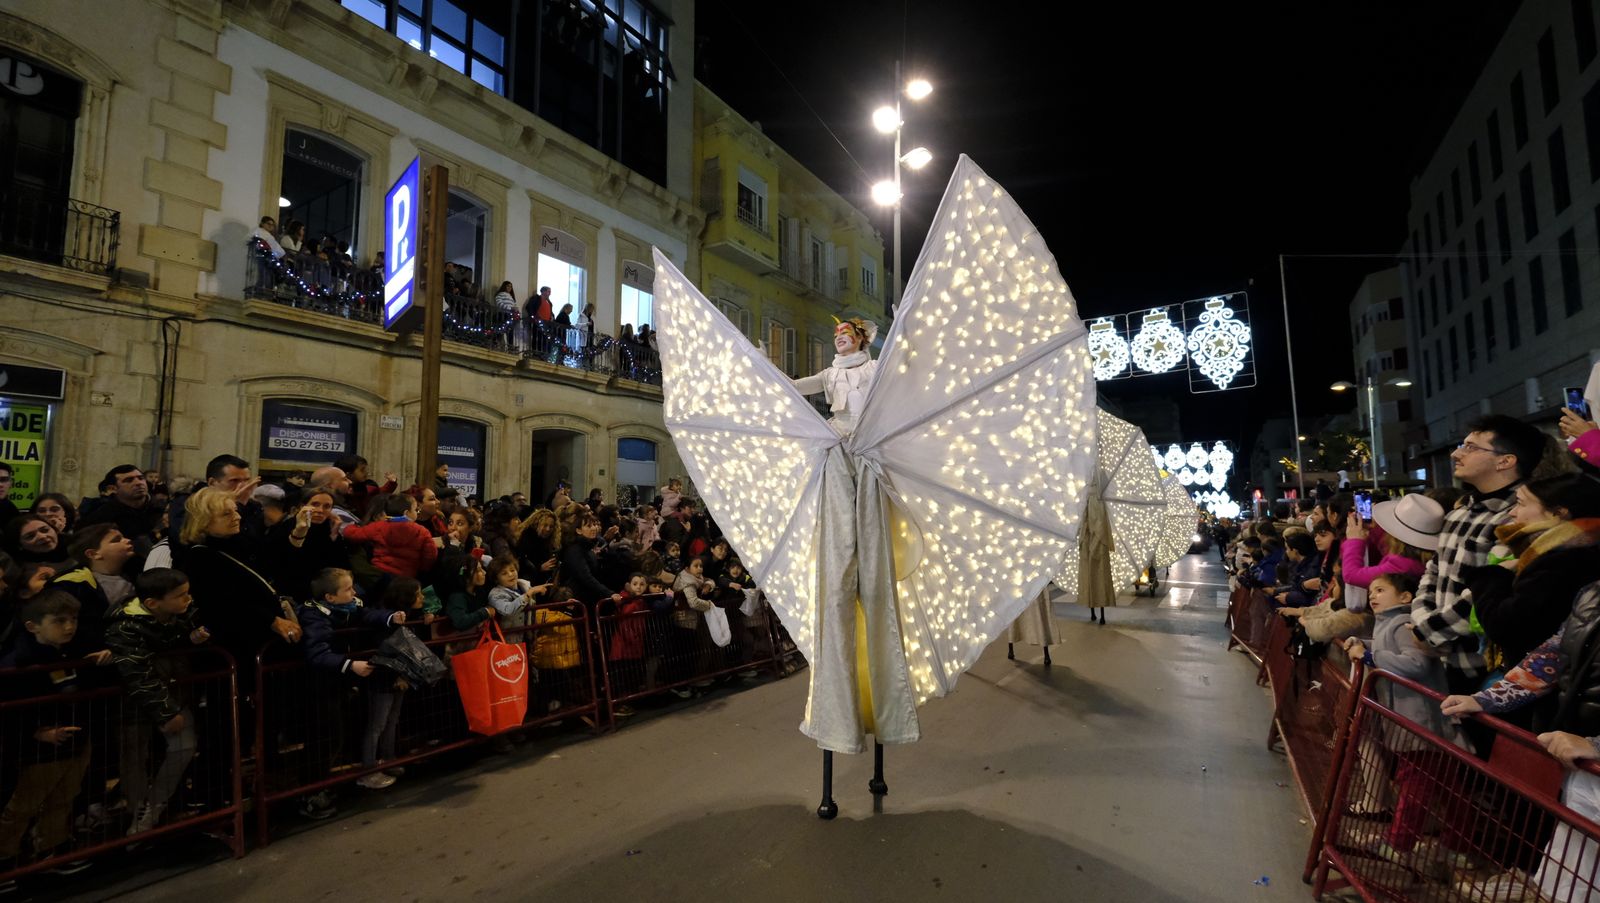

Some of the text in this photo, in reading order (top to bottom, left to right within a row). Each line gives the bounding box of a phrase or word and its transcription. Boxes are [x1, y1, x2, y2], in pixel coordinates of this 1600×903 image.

[279, 429, 337, 442] DISPONIBLE
[0, 440, 39, 461] ILA
[274, 438, 341, 451] 950 27 25 17
[467, 485, 475, 493] 17
